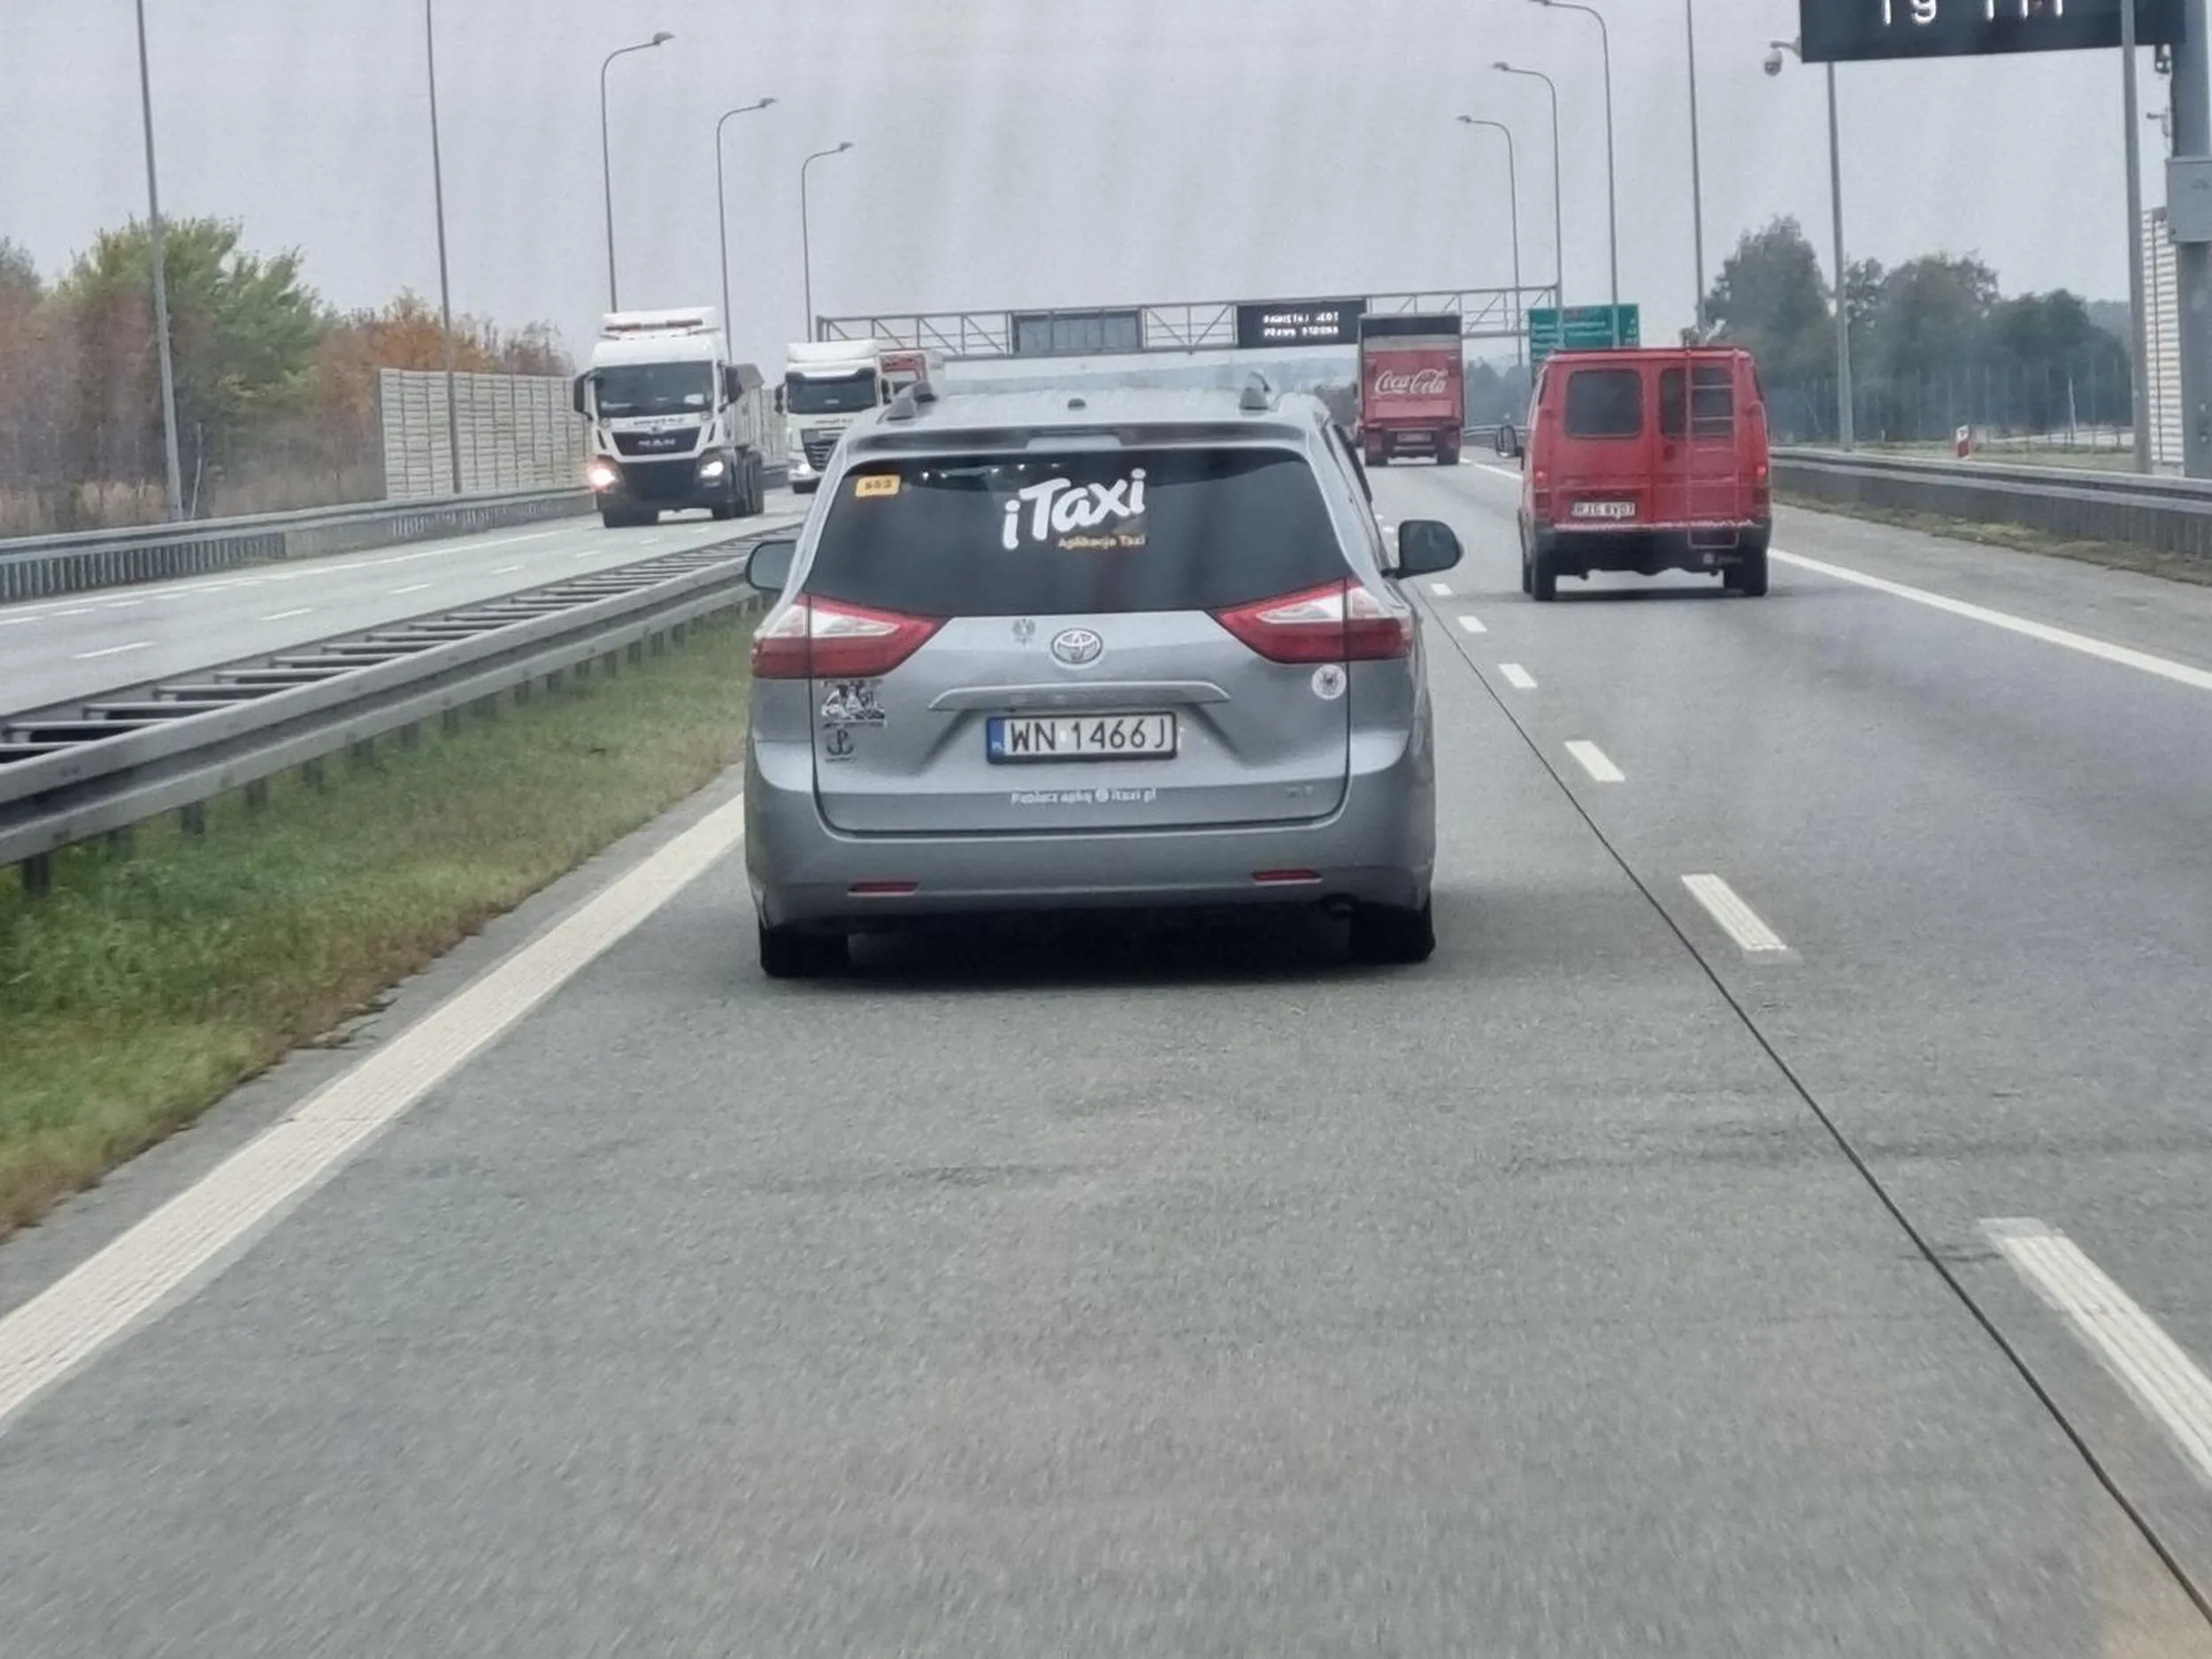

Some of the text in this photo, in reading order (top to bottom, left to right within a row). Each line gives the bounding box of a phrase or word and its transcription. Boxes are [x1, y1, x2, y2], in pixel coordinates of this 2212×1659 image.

[1002, 467, 1147, 550] iTaxi
[1010, 718, 1165, 752] WN 1466J
